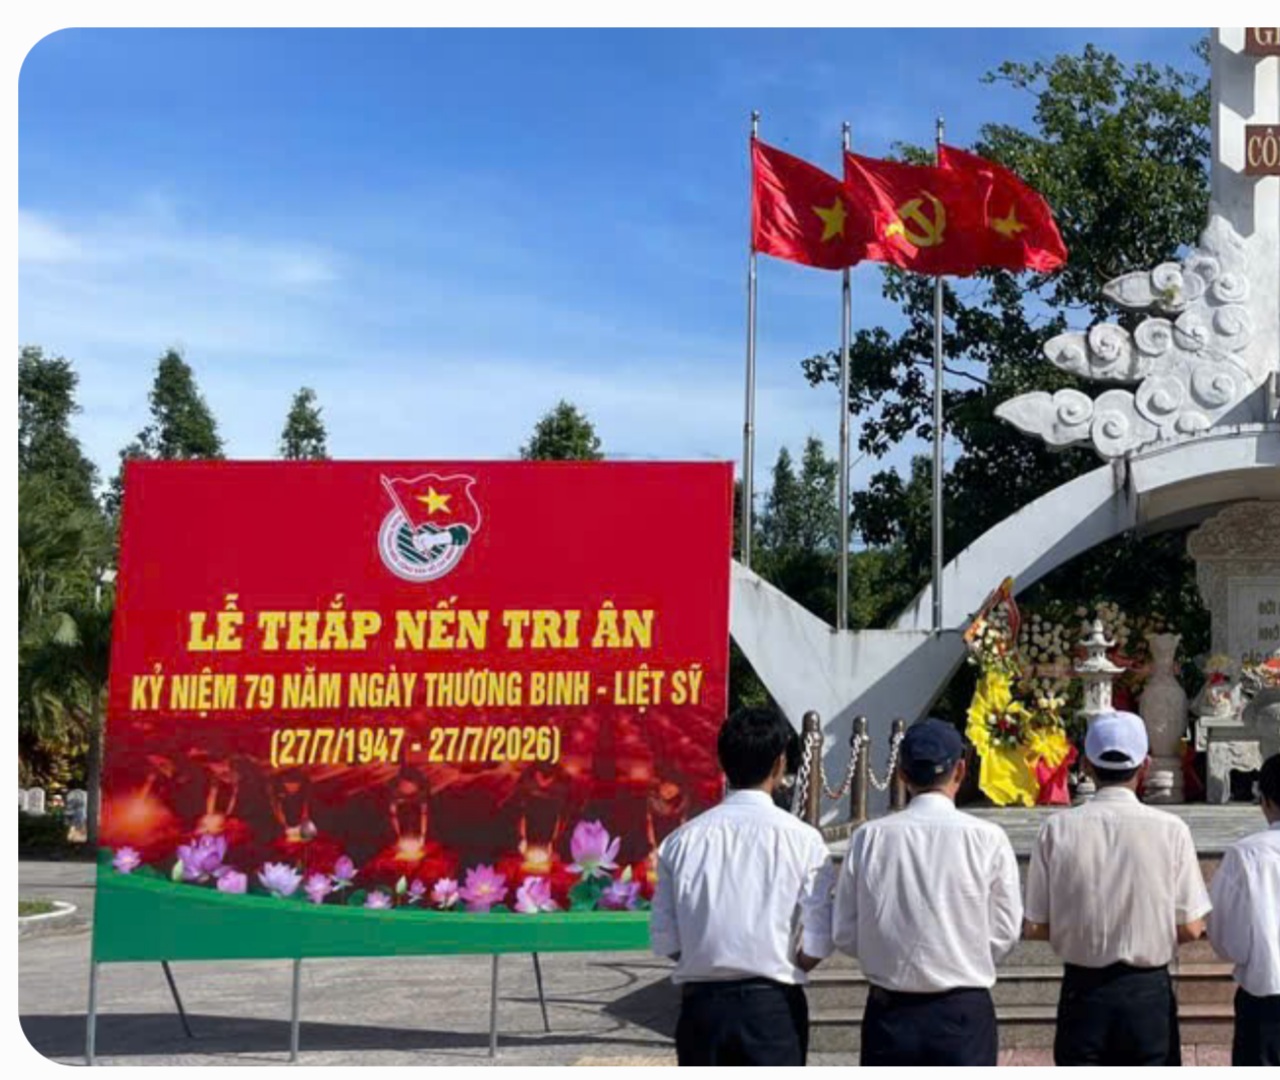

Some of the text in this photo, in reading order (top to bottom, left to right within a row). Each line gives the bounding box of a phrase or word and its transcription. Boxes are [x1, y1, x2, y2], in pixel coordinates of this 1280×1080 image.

[187, 593, 655, 651] LỄ THẮP NẾN TRI ÂN
[131, 662, 165, 711] KỶ
[170, 667, 238, 718] NIỆM
[244, 674, 276, 710] 79
[281, 666, 342, 709] NĂM
[348, 664, 418, 709] NGÀY
[424, 668, 522, 708] THƯƠNG
[530, 671, 591, 706] BINH
[614, 663, 666, 714] LIỆT
[671, 663, 703, 706] SỸ
[270, 727, 405, 768] (27/7/1947
[428, 726, 561, 765] 27/7/2026)
